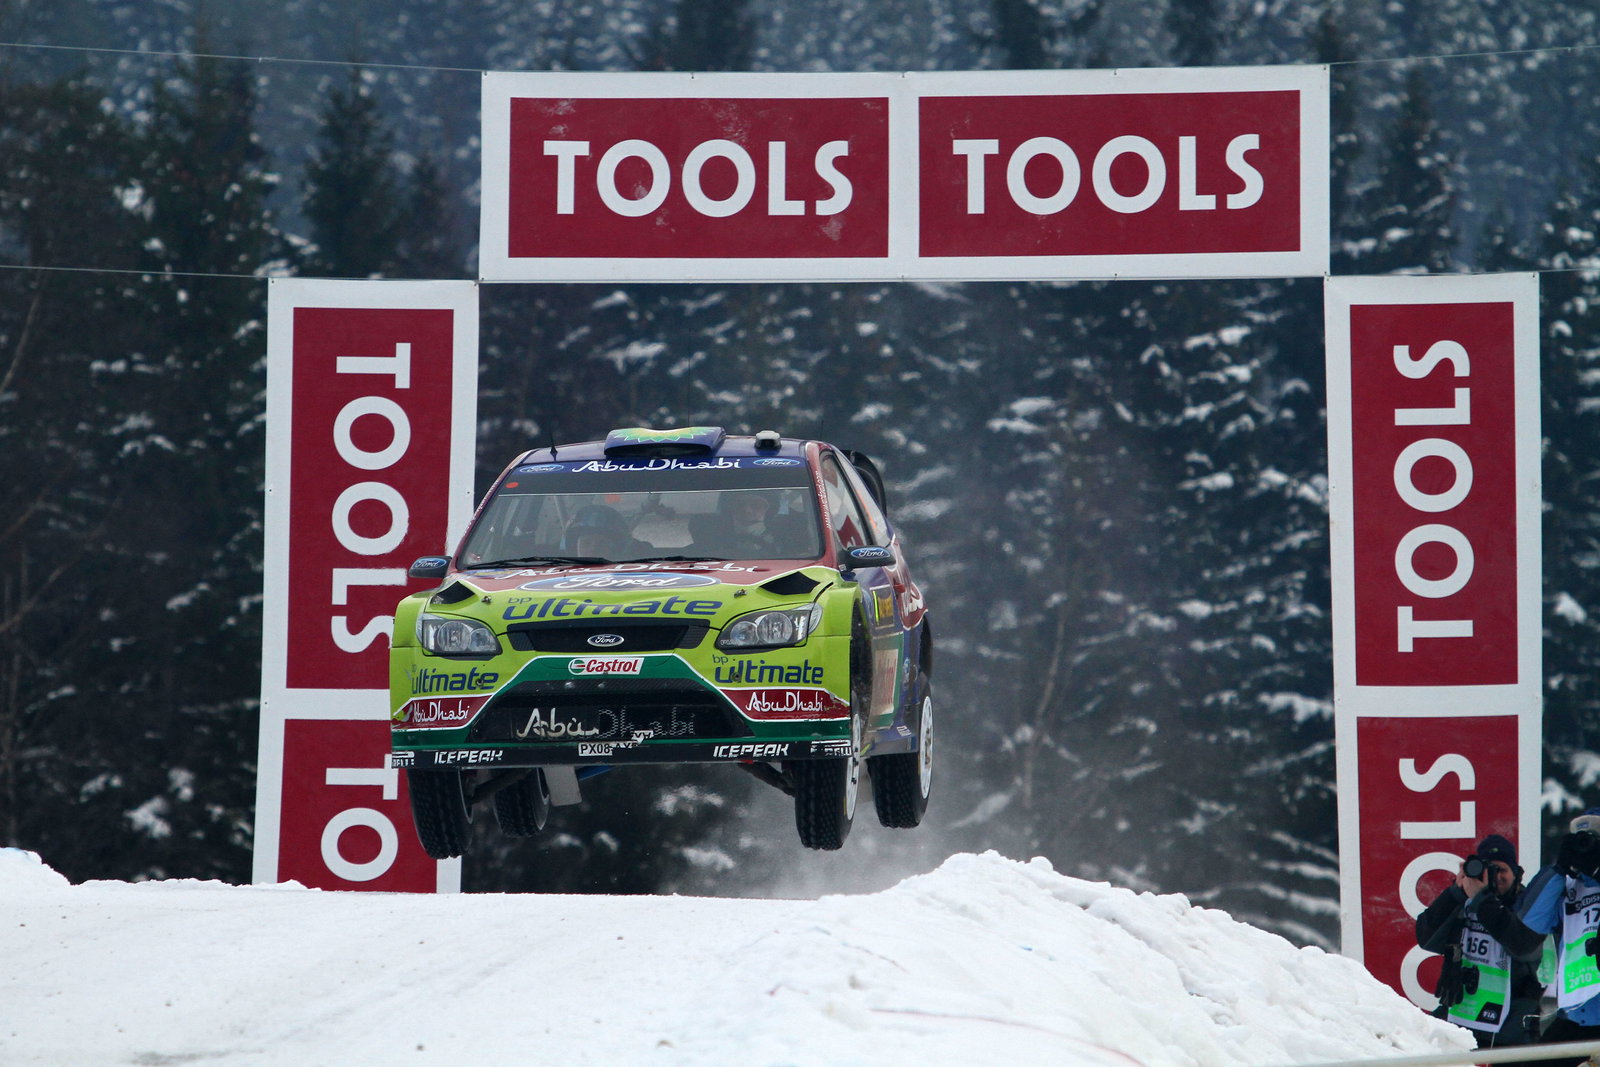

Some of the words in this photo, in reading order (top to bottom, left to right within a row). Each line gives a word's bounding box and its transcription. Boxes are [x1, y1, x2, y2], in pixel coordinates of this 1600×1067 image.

[542, 139, 853, 218] TOOLS
[952, 133, 1265, 216] TOOLS
[331, 342, 412, 654] TOOLS
[1393, 339, 1475, 653] TOOLS
[553, 575, 686, 589] Ford
[502, 596, 723, 621] ultimate
[594, 634, 617, 645] Ford
[586, 659, 639, 673] Castrol
[712, 654, 729, 664] bp
[411, 666, 499, 695] ultimate
[714, 659, 824, 685] ultimate
[433, 750, 503, 765] ICEPEAK
[712, 743, 790, 758] ICEPEAK
[1466, 936, 1490, 956] 156
